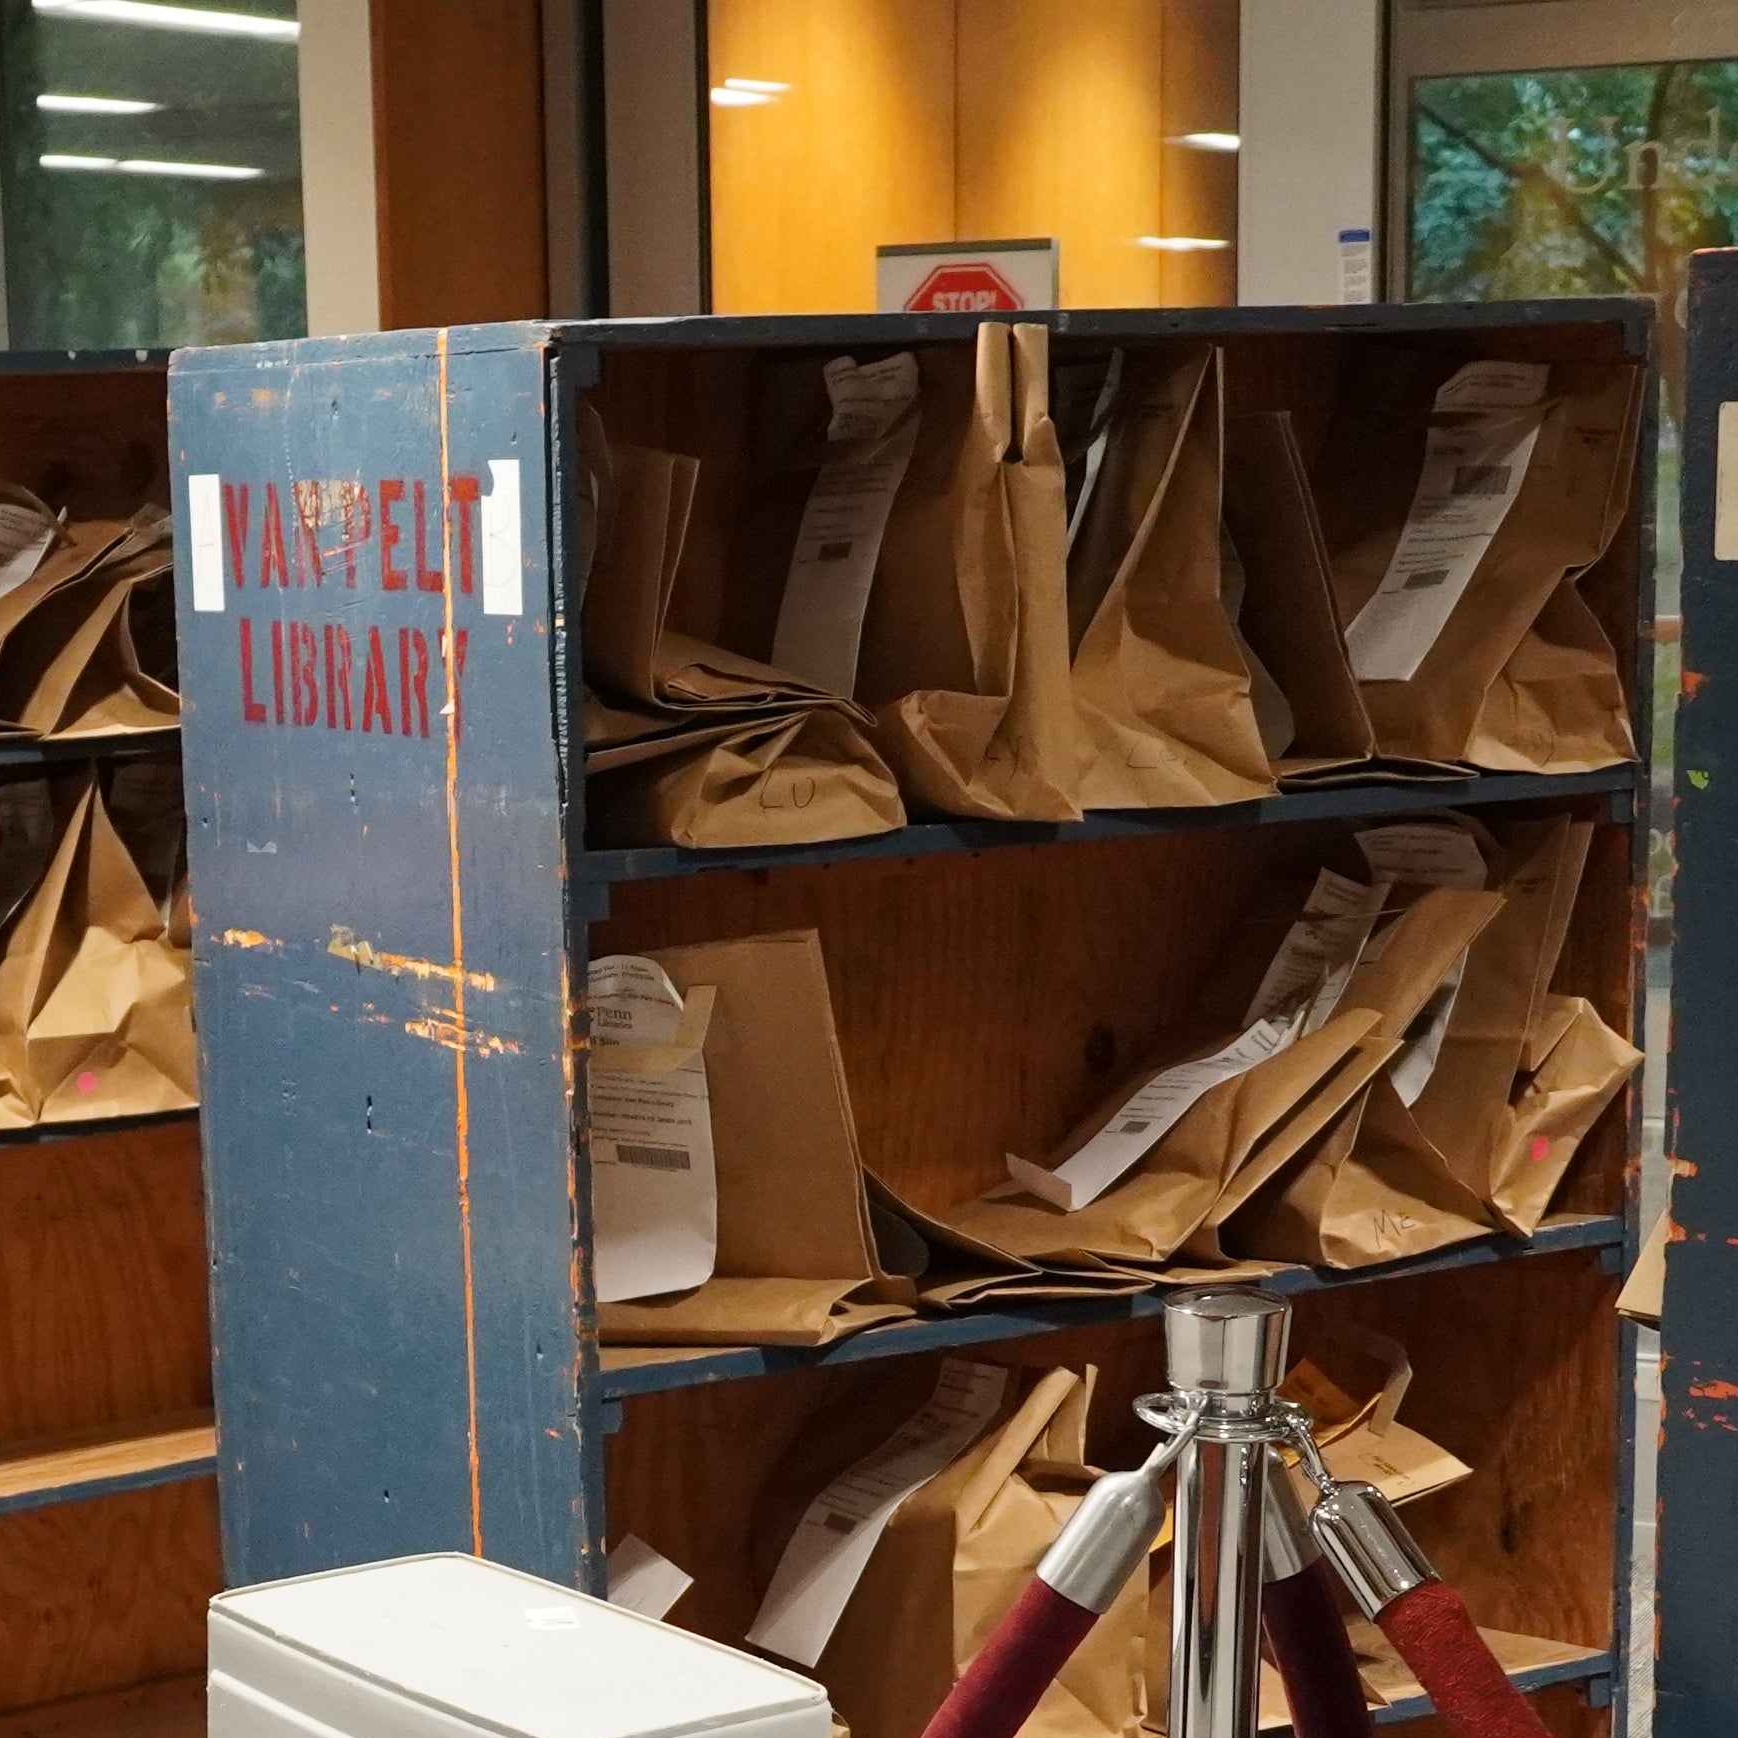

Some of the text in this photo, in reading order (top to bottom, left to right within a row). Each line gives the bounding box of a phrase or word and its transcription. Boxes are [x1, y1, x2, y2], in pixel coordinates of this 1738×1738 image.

[342, 475, 480, 594] PELT
[238, 617, 470, 743] LIBRARY
[1373, 1209, 1416, 1250] ME
